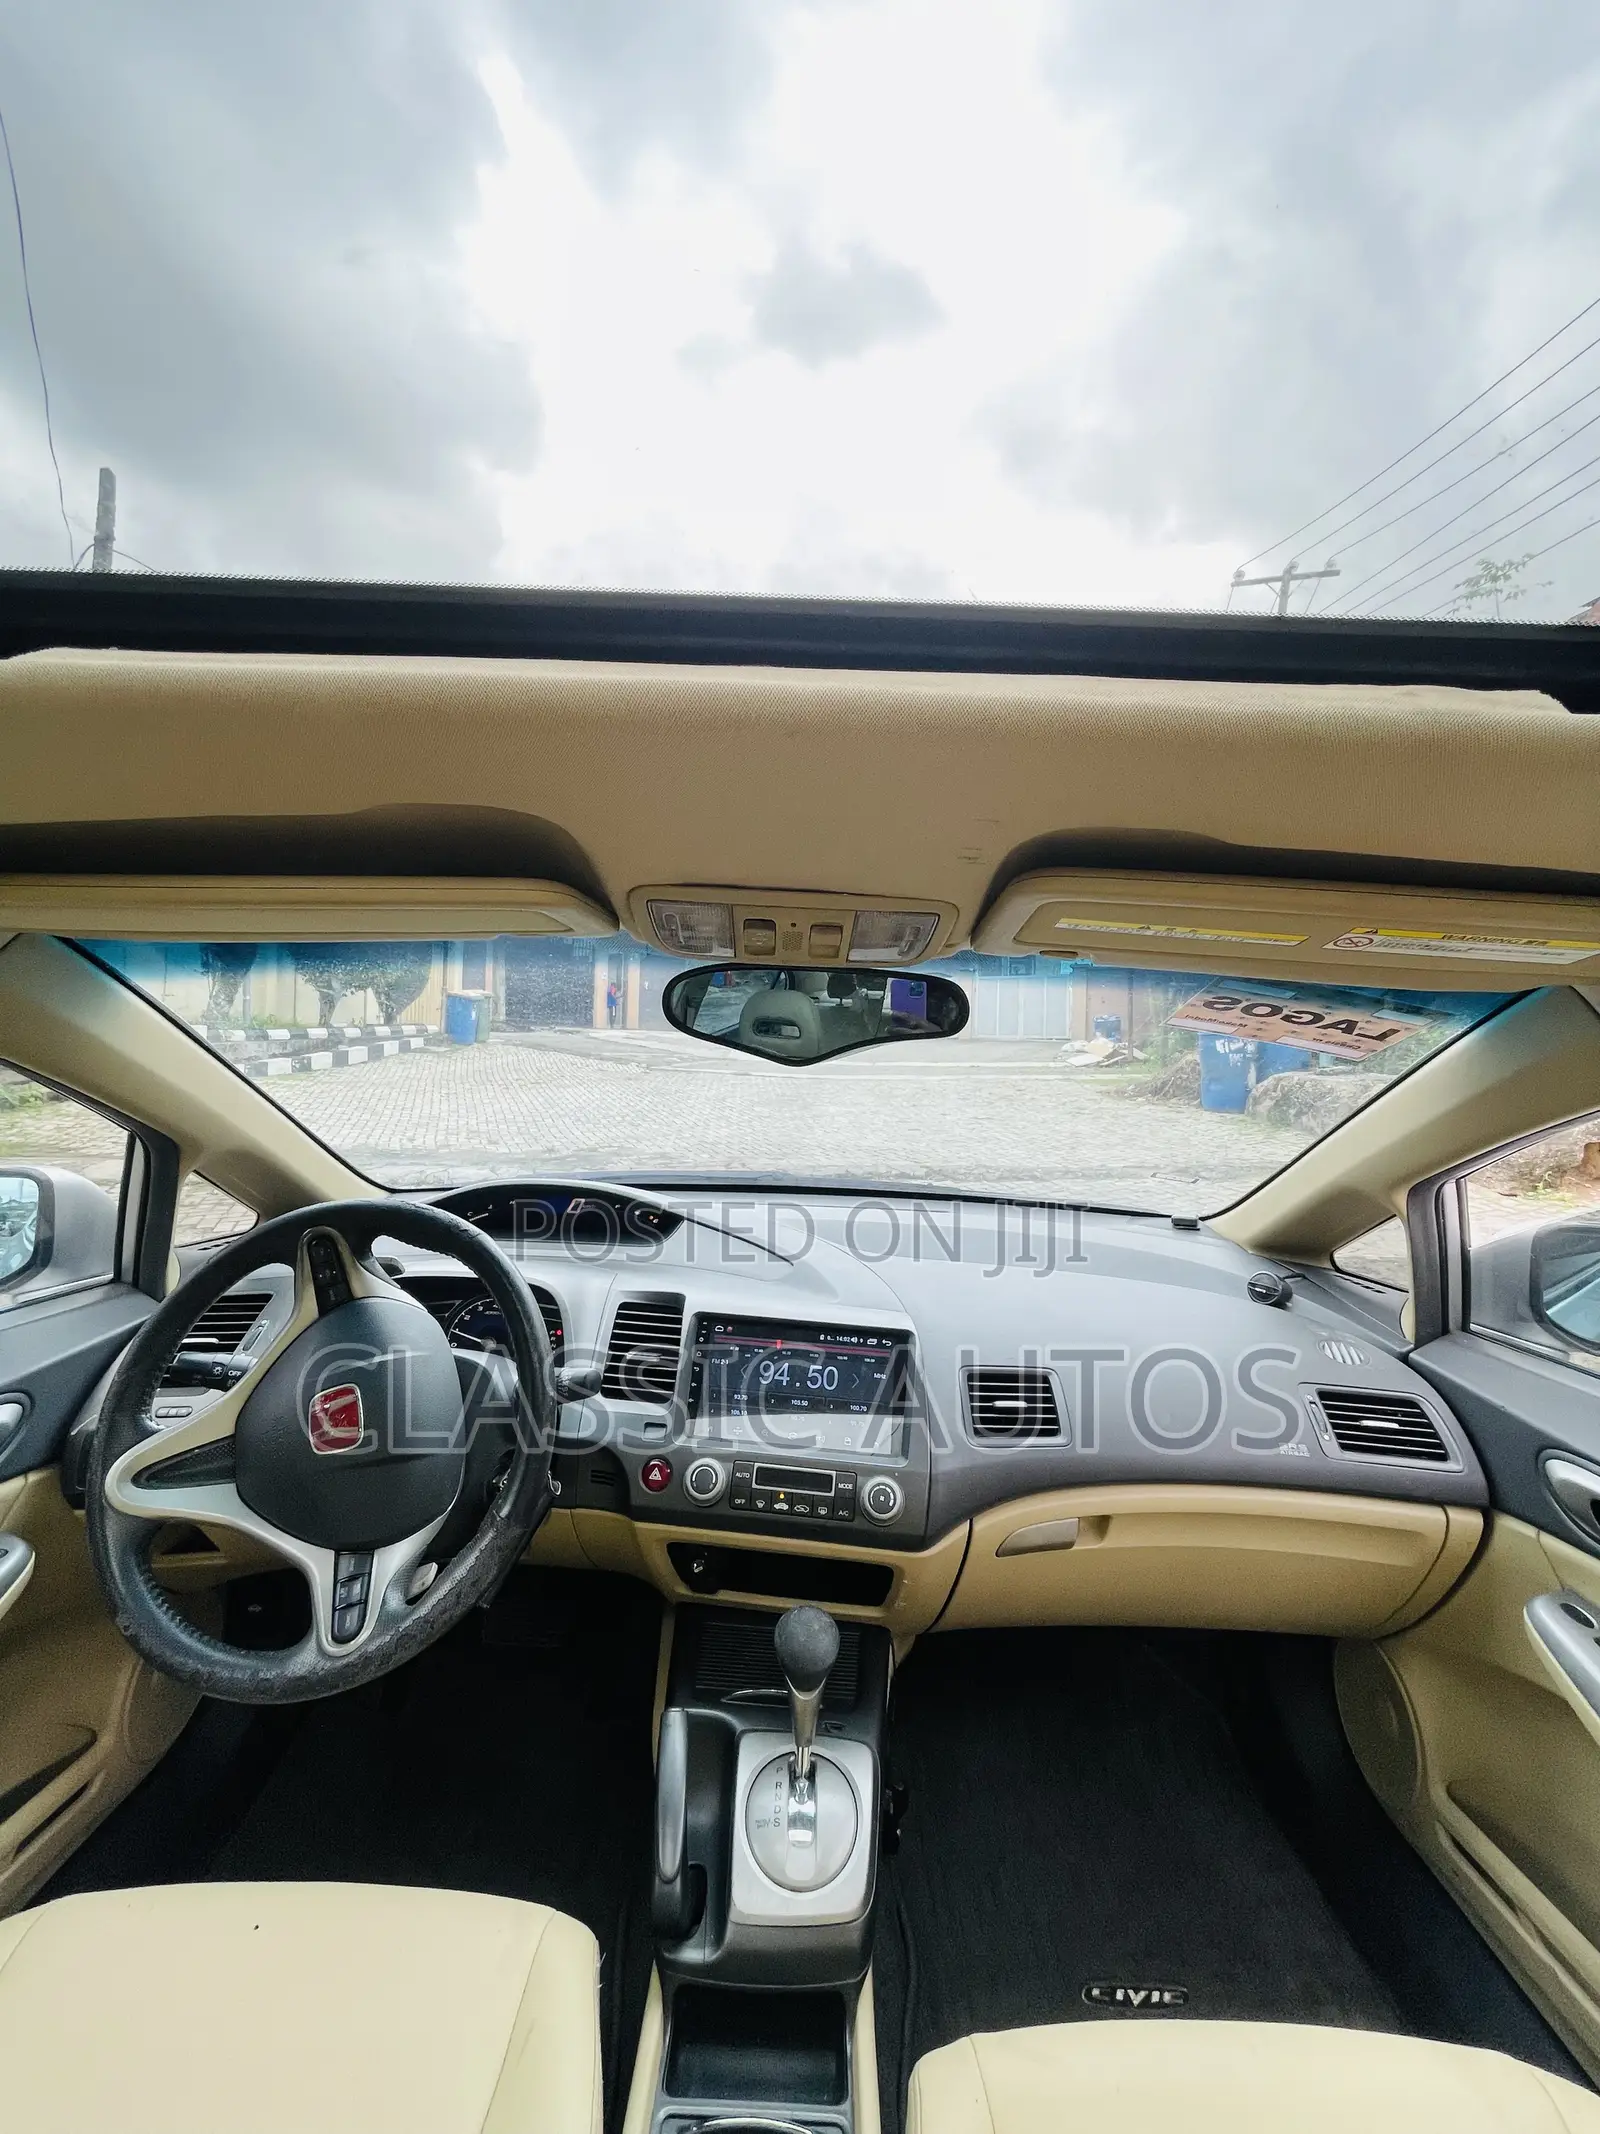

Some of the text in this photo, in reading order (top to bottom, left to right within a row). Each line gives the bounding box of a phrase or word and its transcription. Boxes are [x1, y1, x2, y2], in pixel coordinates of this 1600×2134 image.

[1441, 933, 1521, 946] WARNING
[759, 1360, 839, 1390] 94.50
[735, 1471, 750, 1479] AUTO
[838, 1482, 853, 1490] MODE
[838, 1509, 849, 1517] A/C
[776, 1766, 783, 1774] P
[775, 1781, 783, 1790] R
[774, 1805, 781, 1814] D
[773, 1817, 780, 1827] S
[1091, 1986, 1184, 2008] CIVIC
